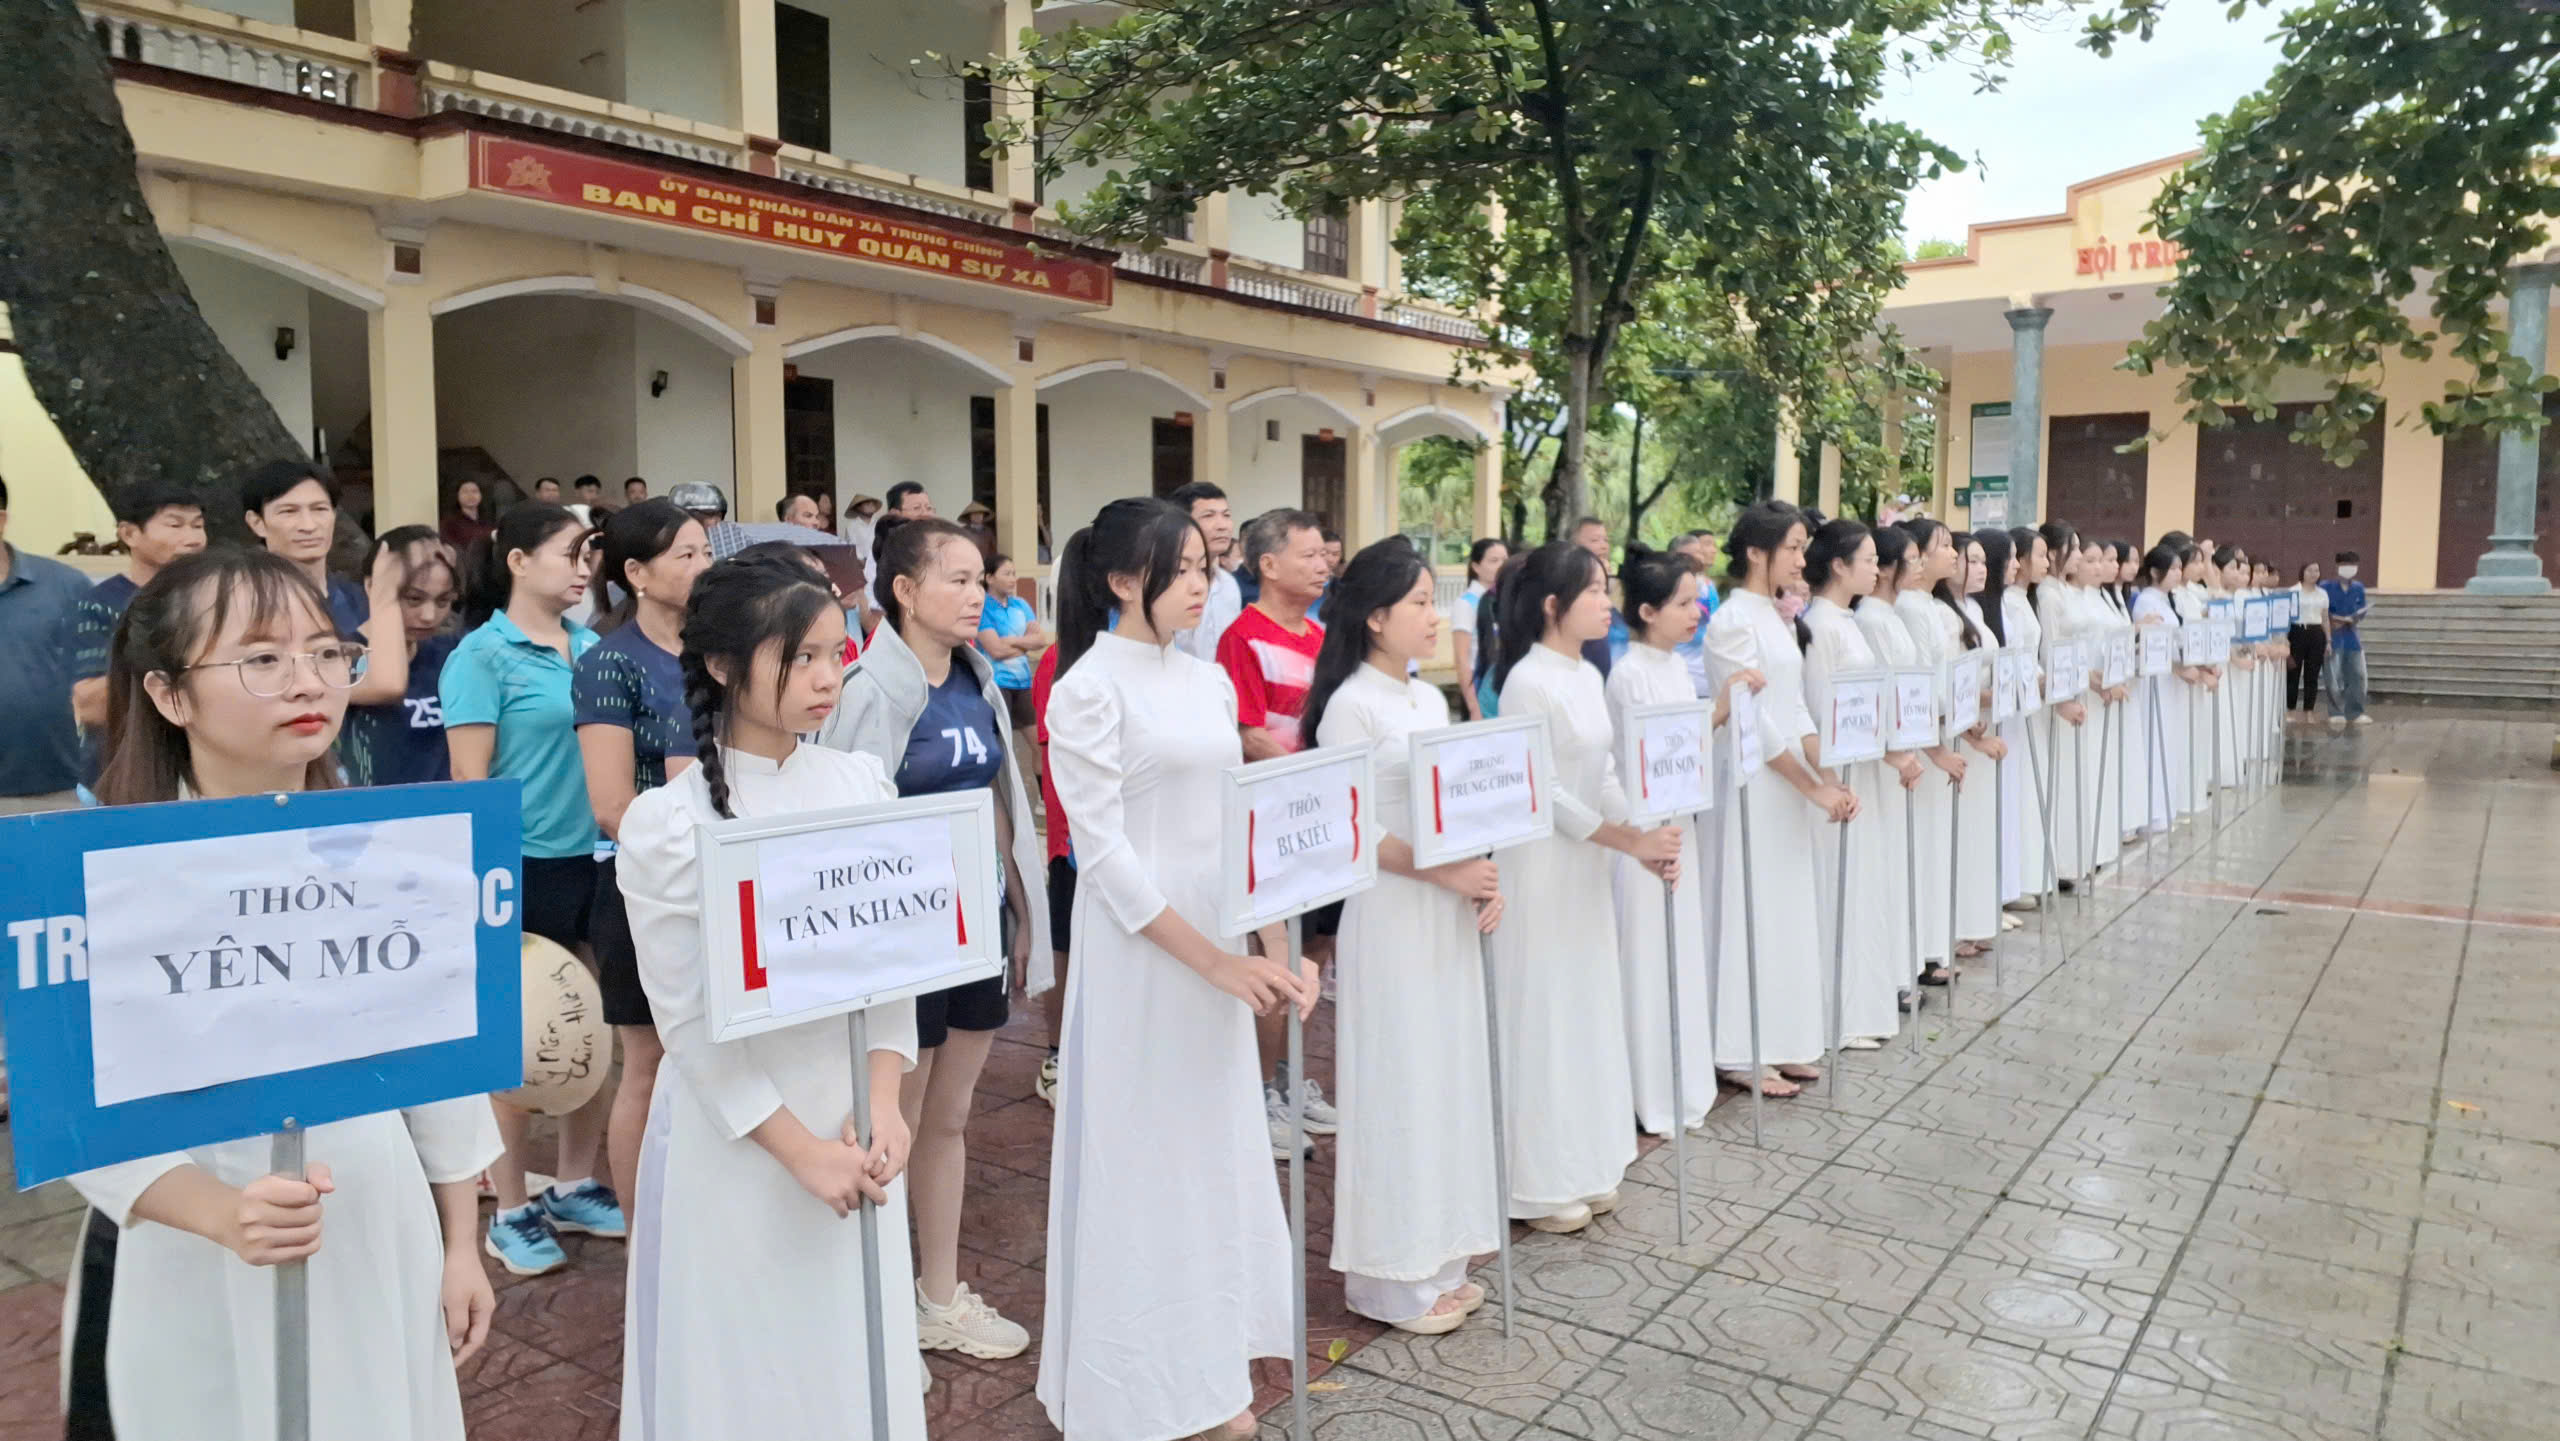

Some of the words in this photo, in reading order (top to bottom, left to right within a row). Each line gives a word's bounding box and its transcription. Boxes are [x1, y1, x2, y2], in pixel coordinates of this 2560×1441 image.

[582, 183, 677, 217] BAN
[773, 221, 847, 248] HUY
[696, 187, 742, 206] BAN
[889, 226, 948, 247] TRUNG
[403, 696, 445, 728] 25
[941, 727, 987, 768] 74
[229, 875, 359, 917] THÔN
[813, 855, 913, 891] TRƯỜNG
[779, 905, 839, 942] TÂN
[849, 887, 948, 929] KHANG
[152, 935, 295, 996] YÊN
[316, 920, 422, 979] MỖ
